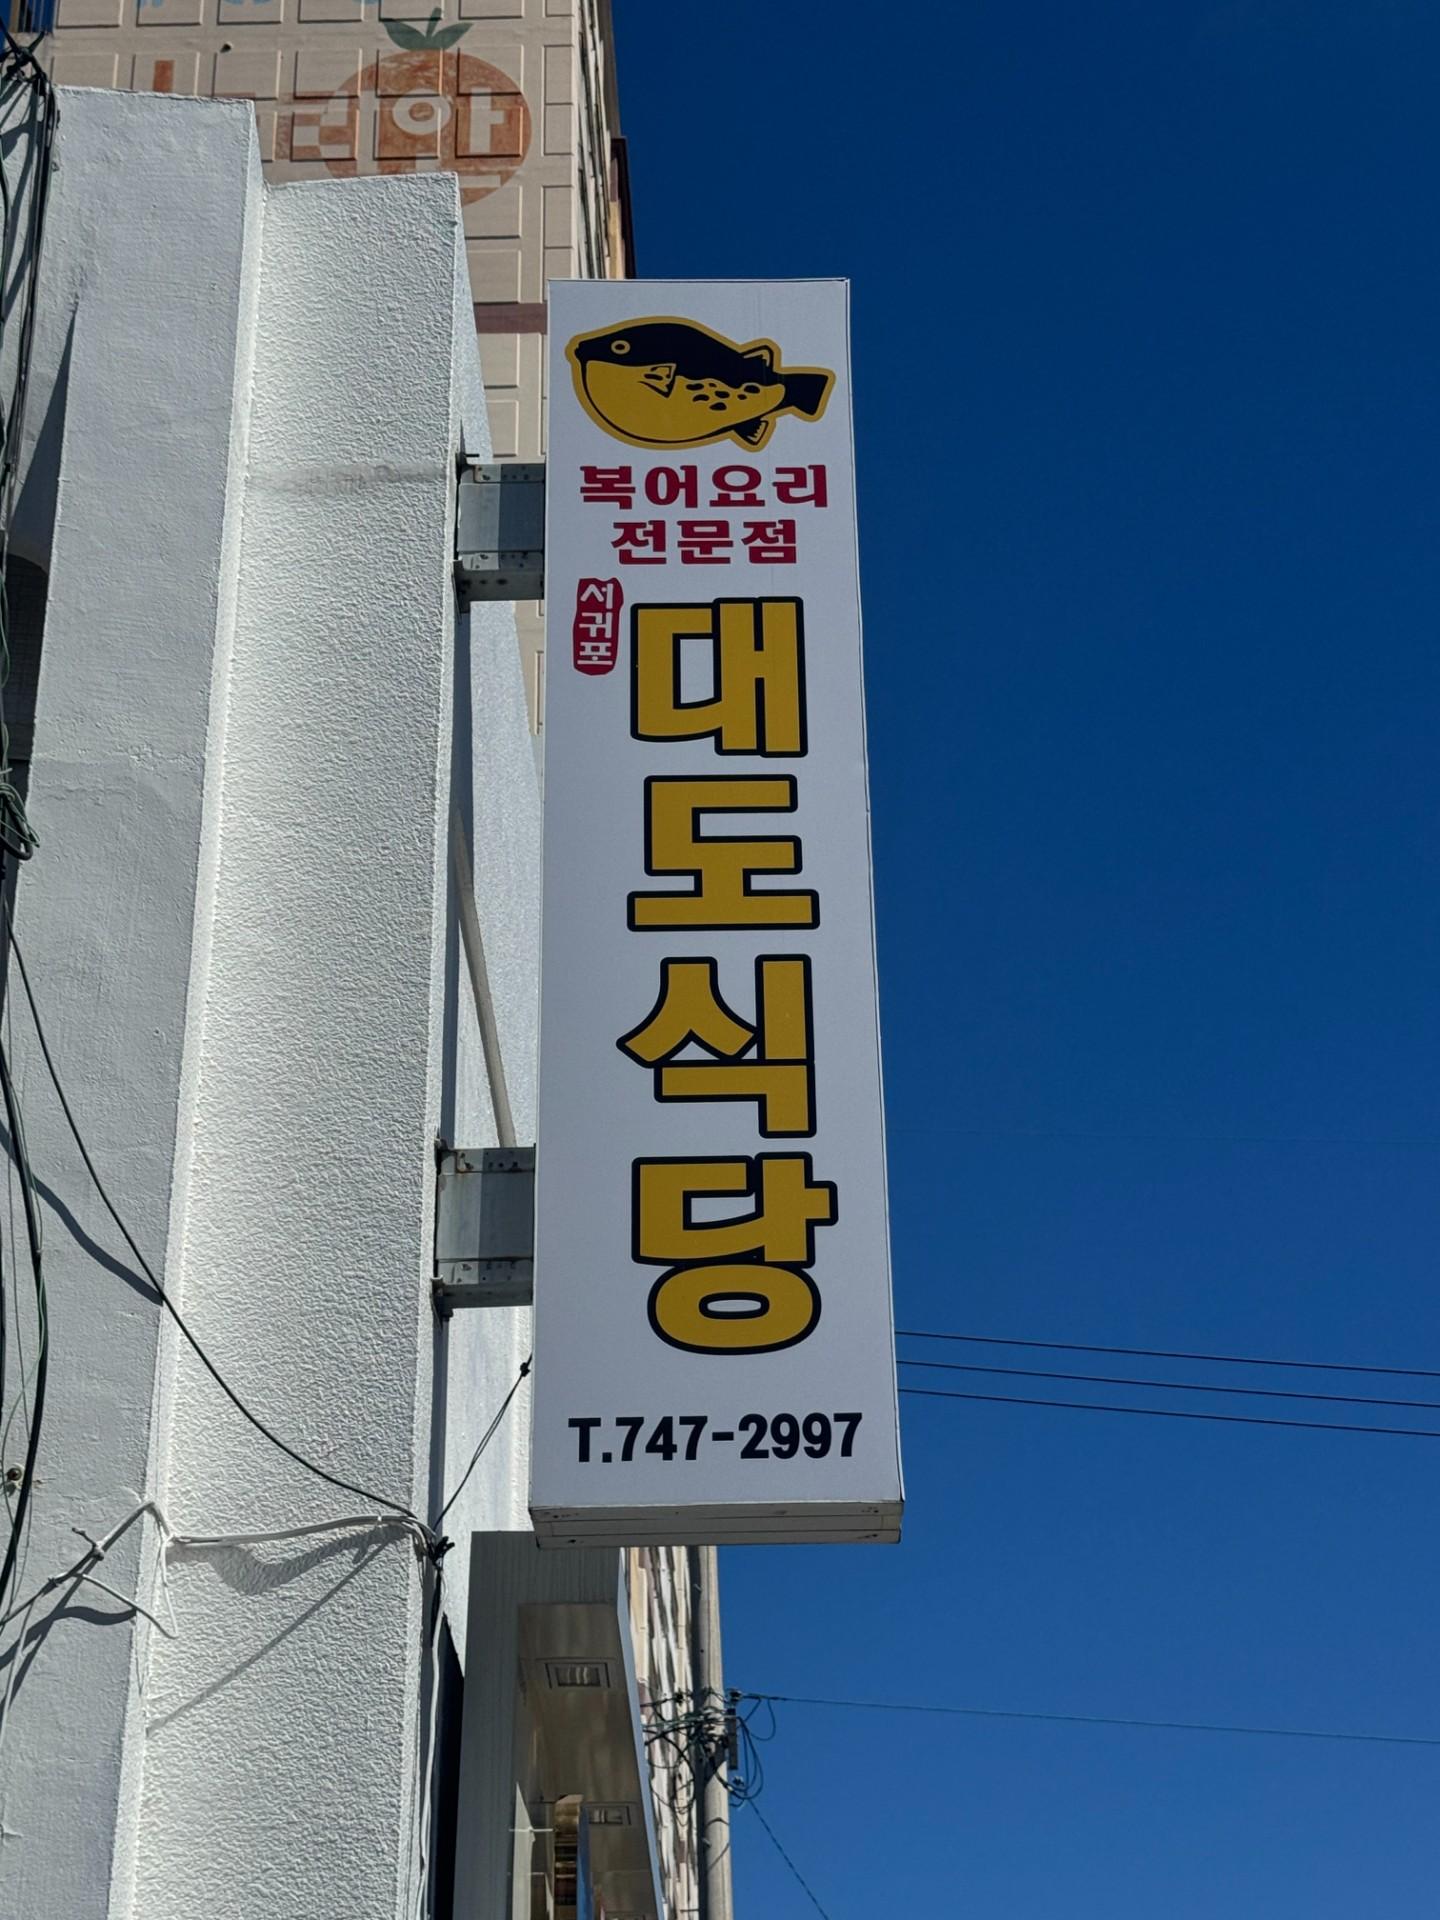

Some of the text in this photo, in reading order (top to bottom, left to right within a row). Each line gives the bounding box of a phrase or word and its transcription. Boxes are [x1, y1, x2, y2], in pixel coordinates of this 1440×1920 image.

[580, 465, 828, 510] 복어요리
[610, 519, 797, 565] 전문점
[577, 582, 615, 666] 서귀포
[616, 597, 838, 1356] 대도식당
[567, 1412, 863, 1463] T.747-2997
